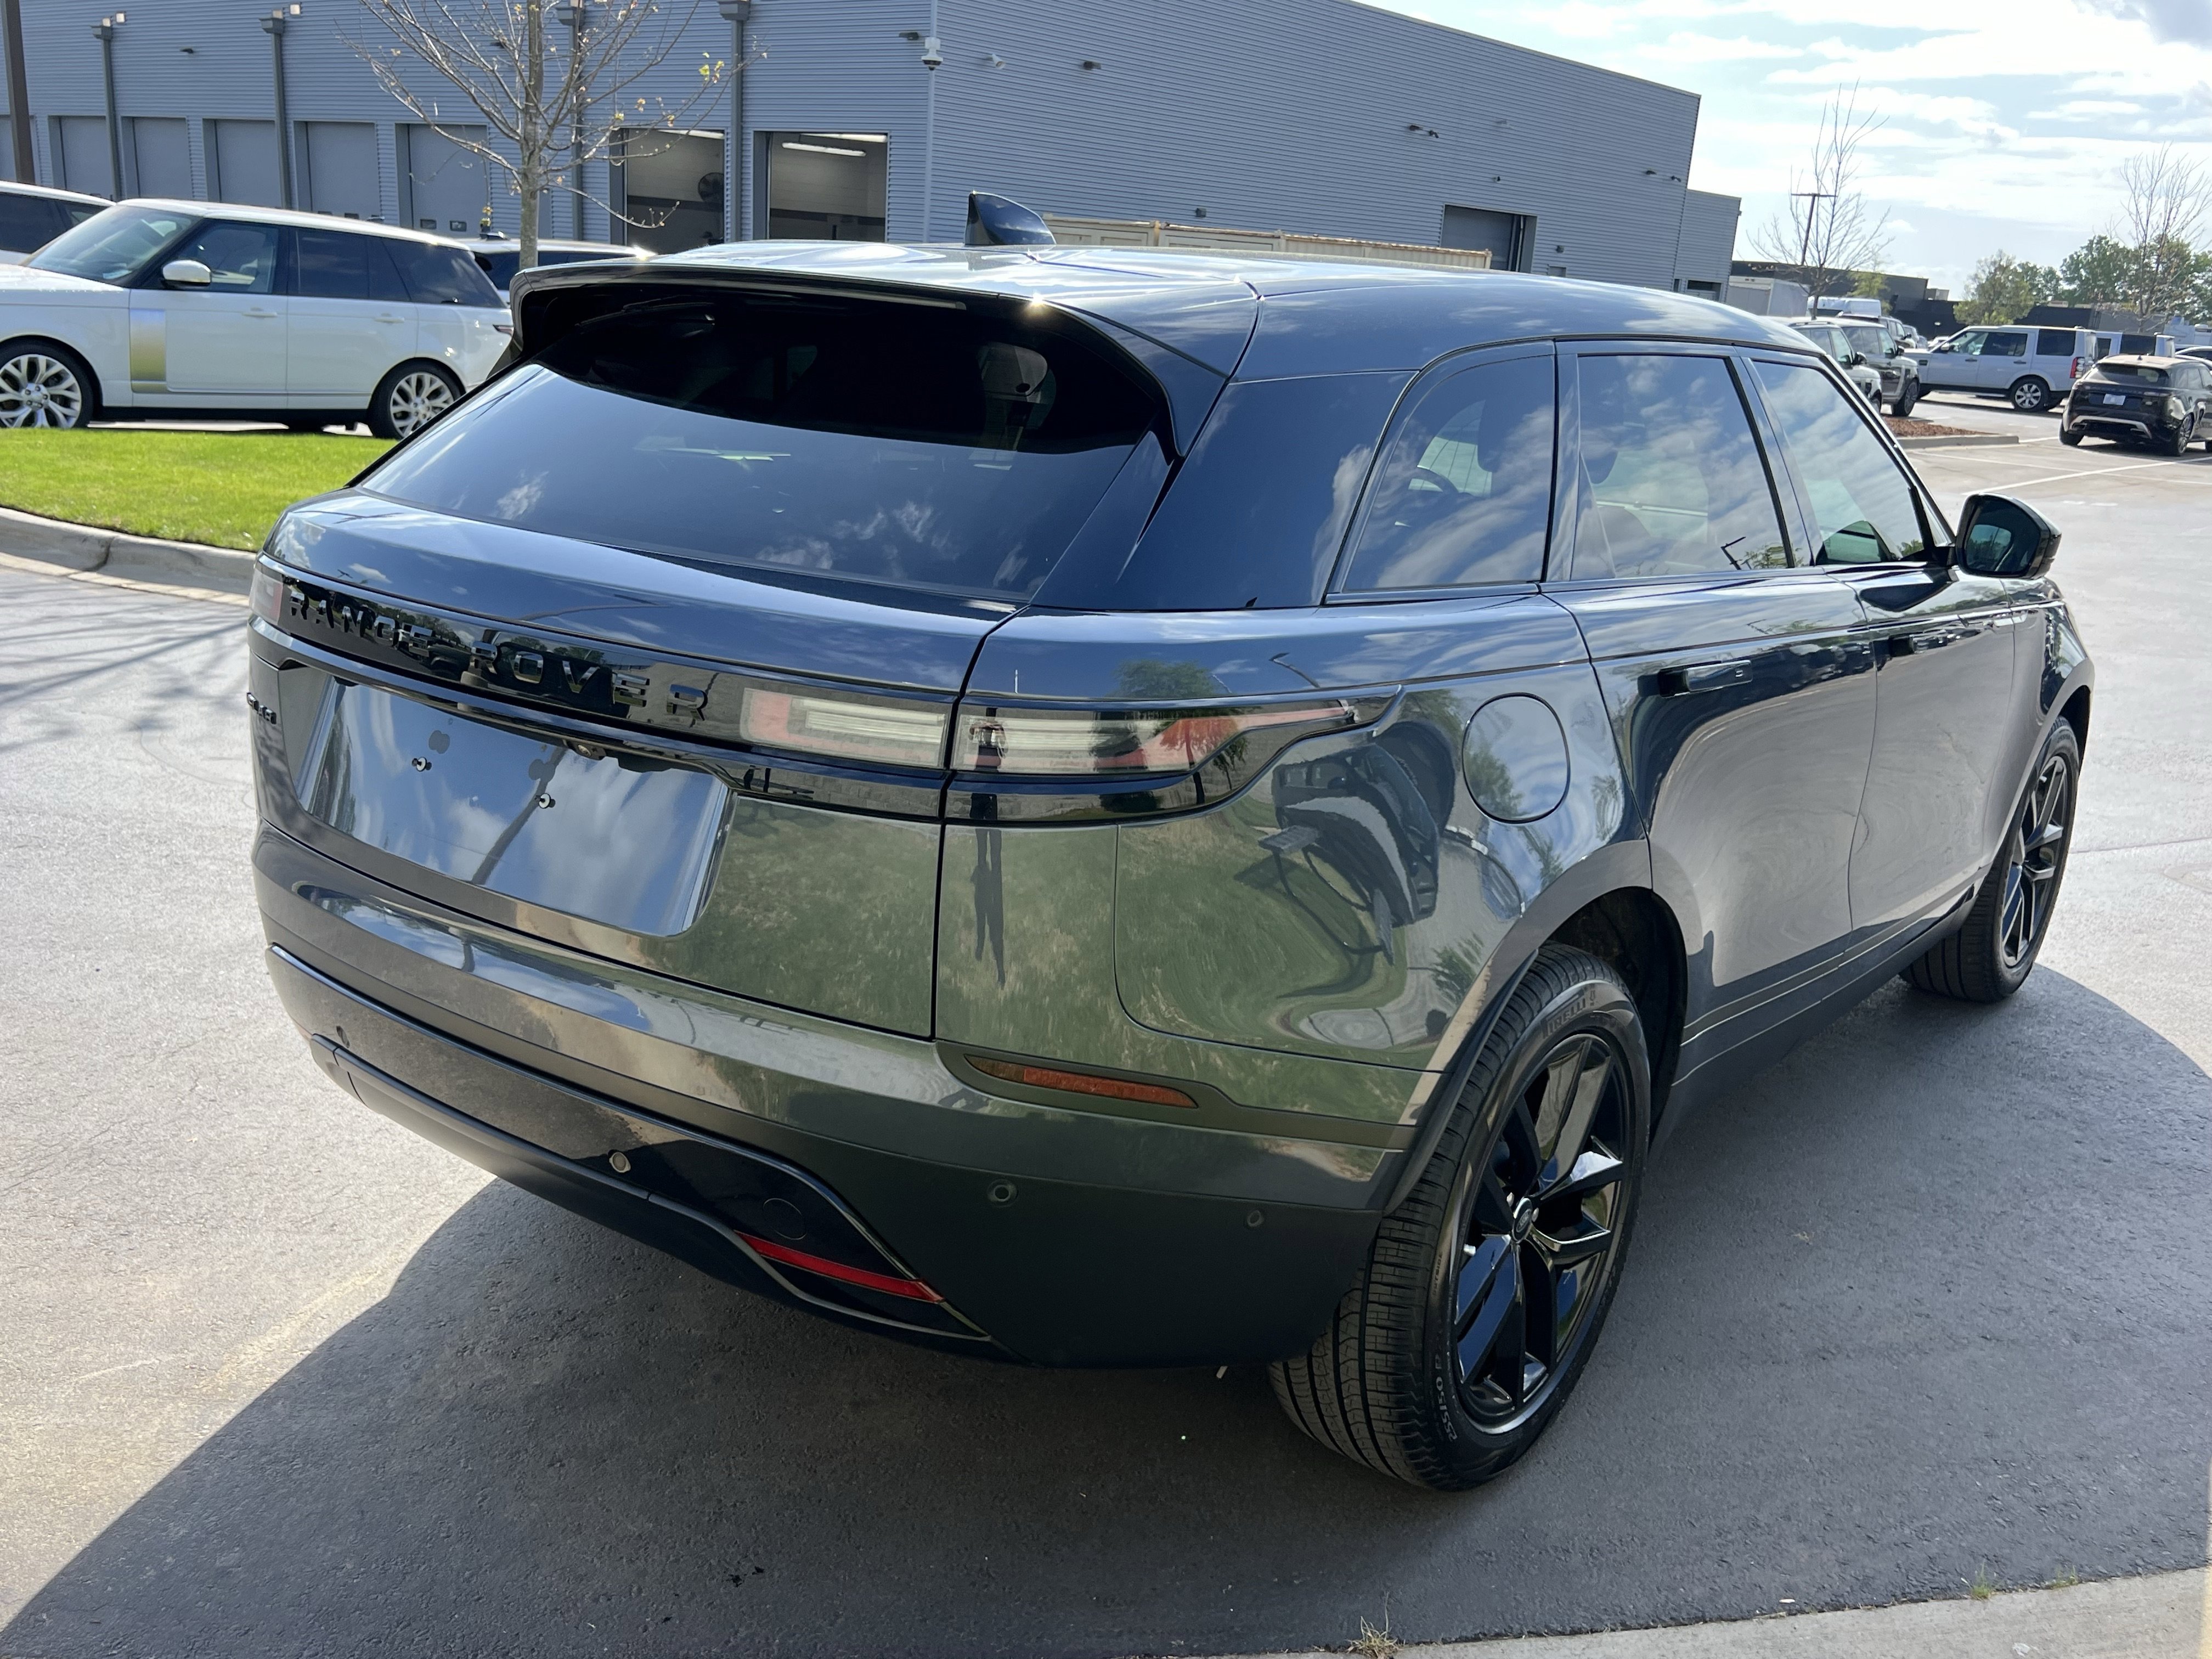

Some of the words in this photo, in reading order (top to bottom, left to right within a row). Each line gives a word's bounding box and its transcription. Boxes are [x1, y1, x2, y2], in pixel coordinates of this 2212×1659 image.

[290, 591, 435, 657] RANGE
[470, 641, 708, 720] ROVER
[1541, 988, 1585, 1039] PIRELLI
